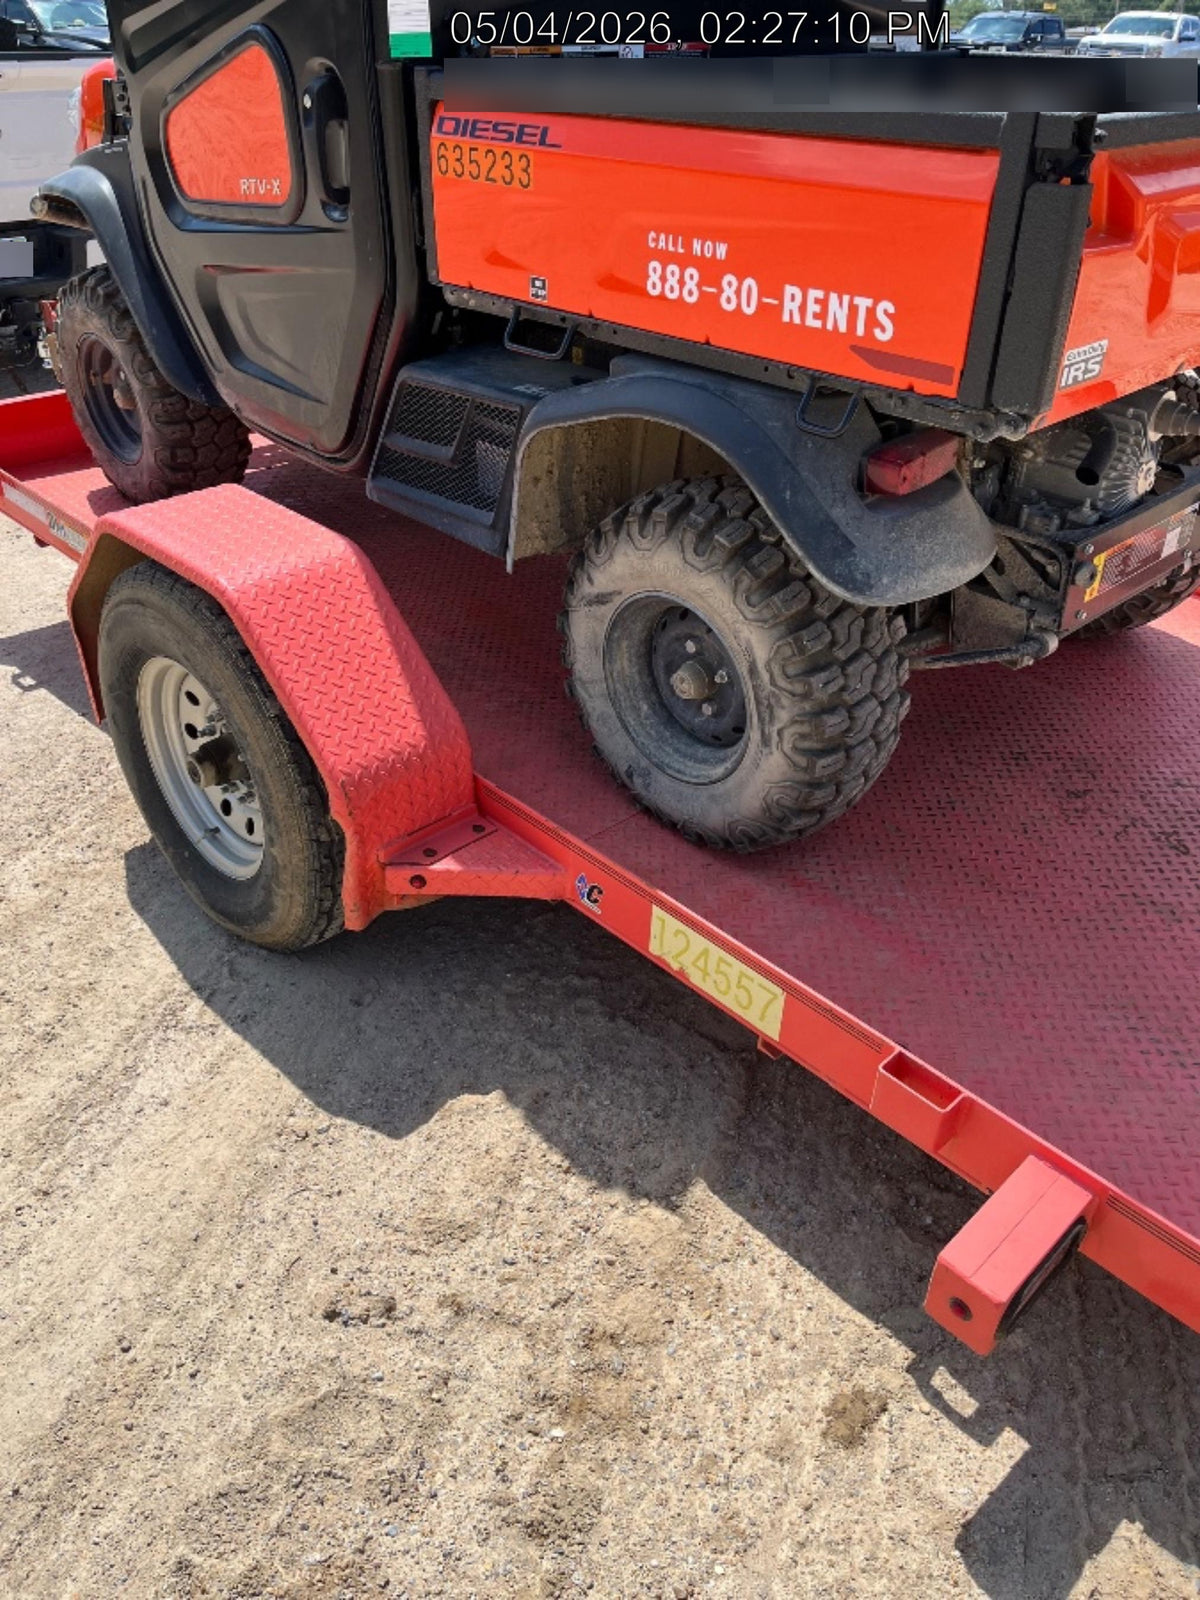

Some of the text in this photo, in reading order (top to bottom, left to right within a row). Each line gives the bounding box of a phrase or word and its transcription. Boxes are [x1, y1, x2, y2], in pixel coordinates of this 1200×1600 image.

[436, 115, 563, 149] DIESEL
[436, 141, 531, 189] 635233
[240, 178, 280, 196] RTV-X
[647, 230, 729, 261] CALL NOW
[645, 260, 897, 343] 888-80-RENTS
[1061, 355, 1103, 387] IRS
[655, 914, 780, 1024] 124557
